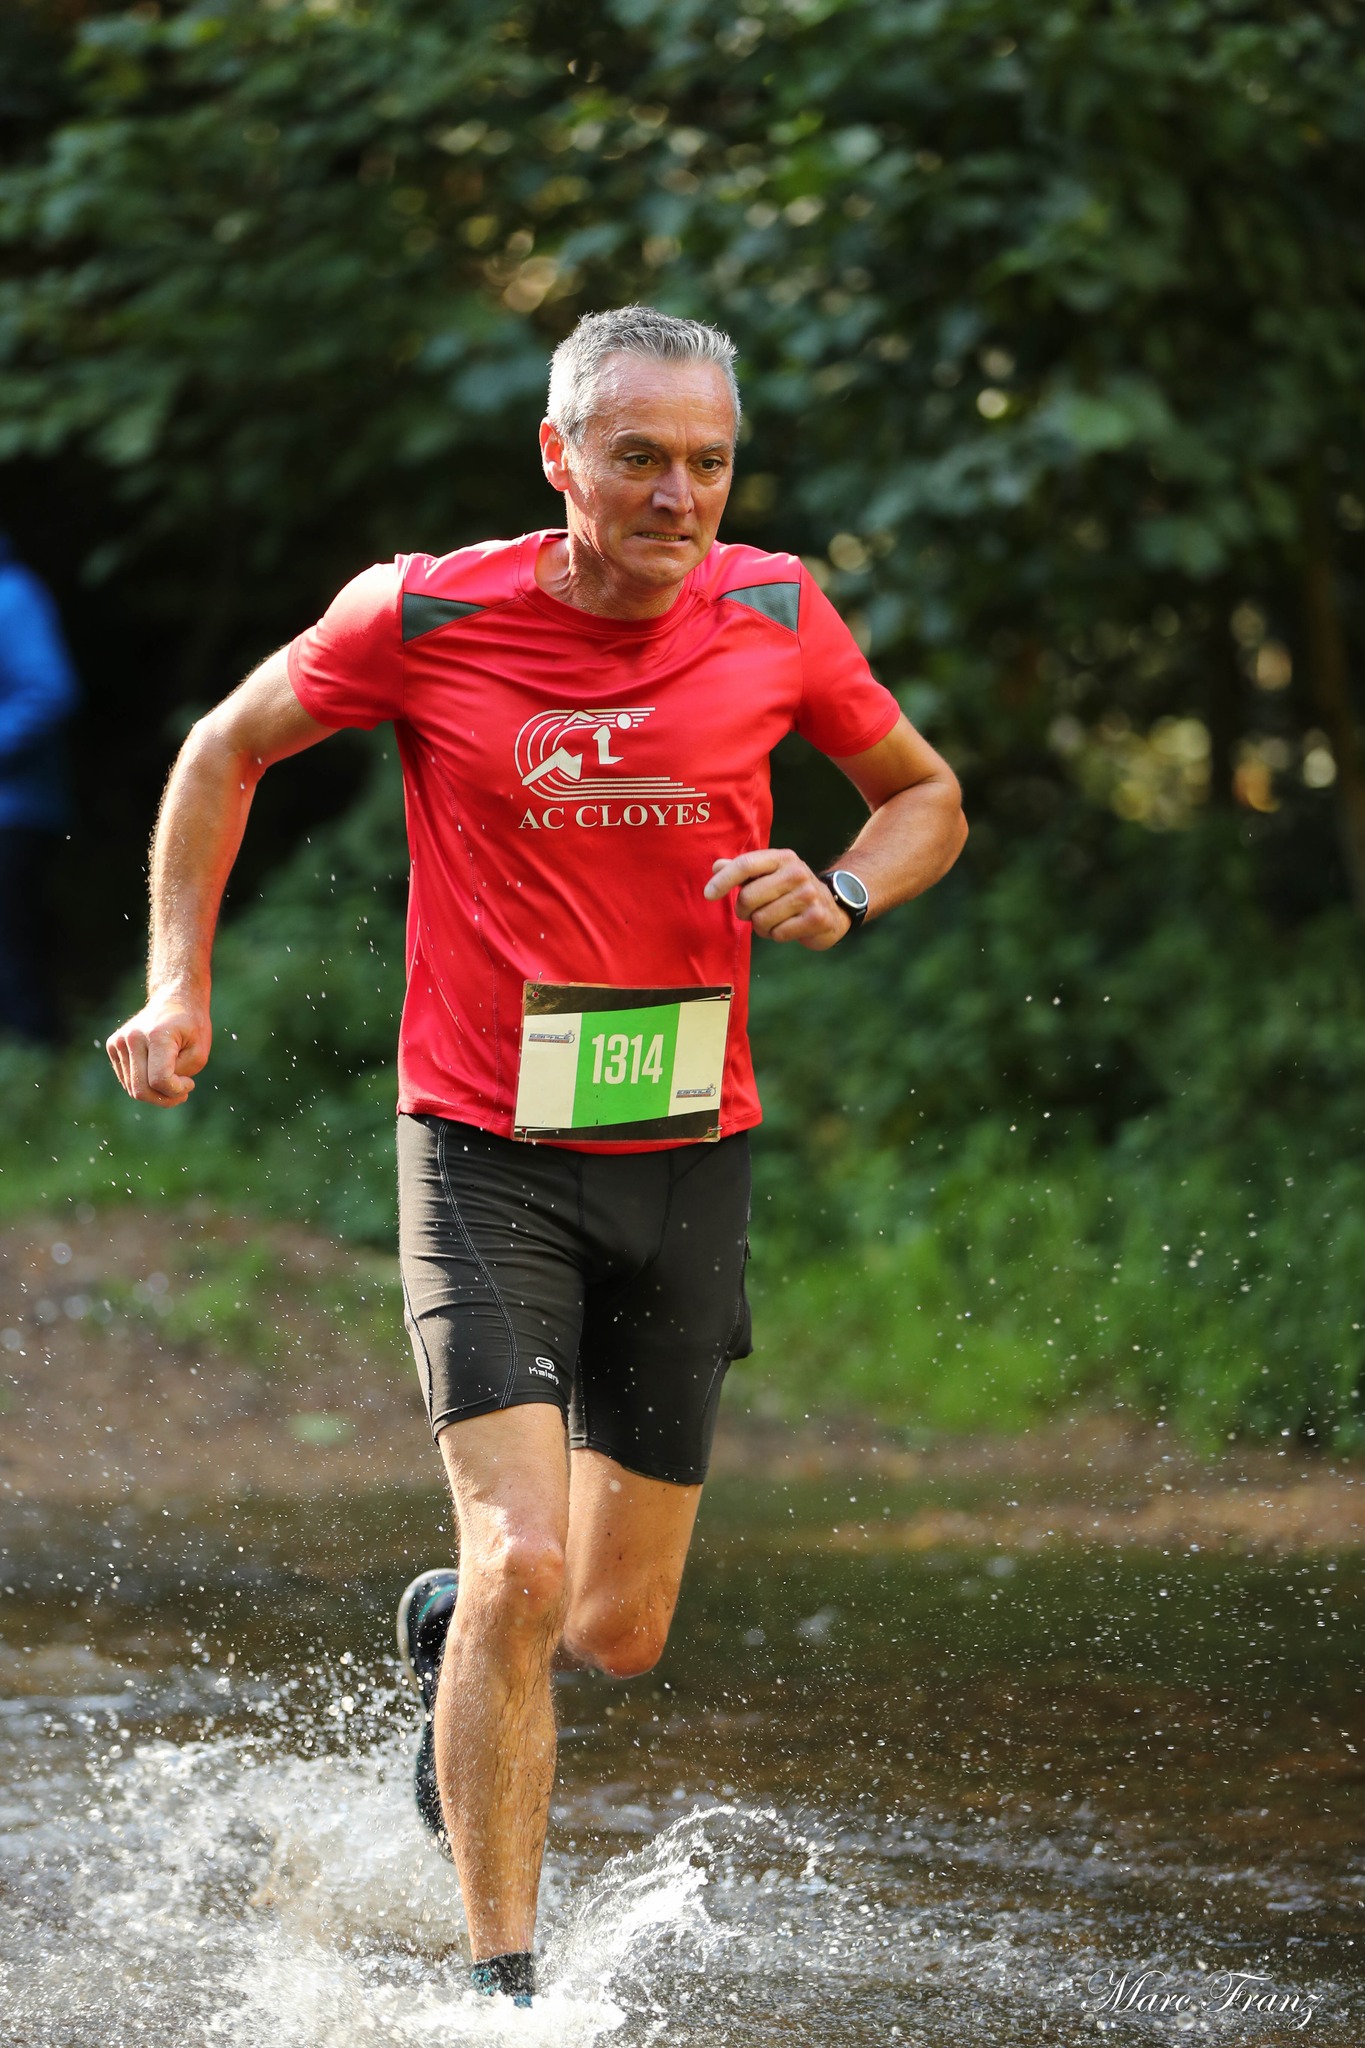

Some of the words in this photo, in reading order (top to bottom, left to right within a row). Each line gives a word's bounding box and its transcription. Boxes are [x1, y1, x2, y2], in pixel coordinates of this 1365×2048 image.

[518, 807, 564, 829] AC
[575, 802, 711, 828] CLOYES
[592, 1034, 664, 1084] 1314
